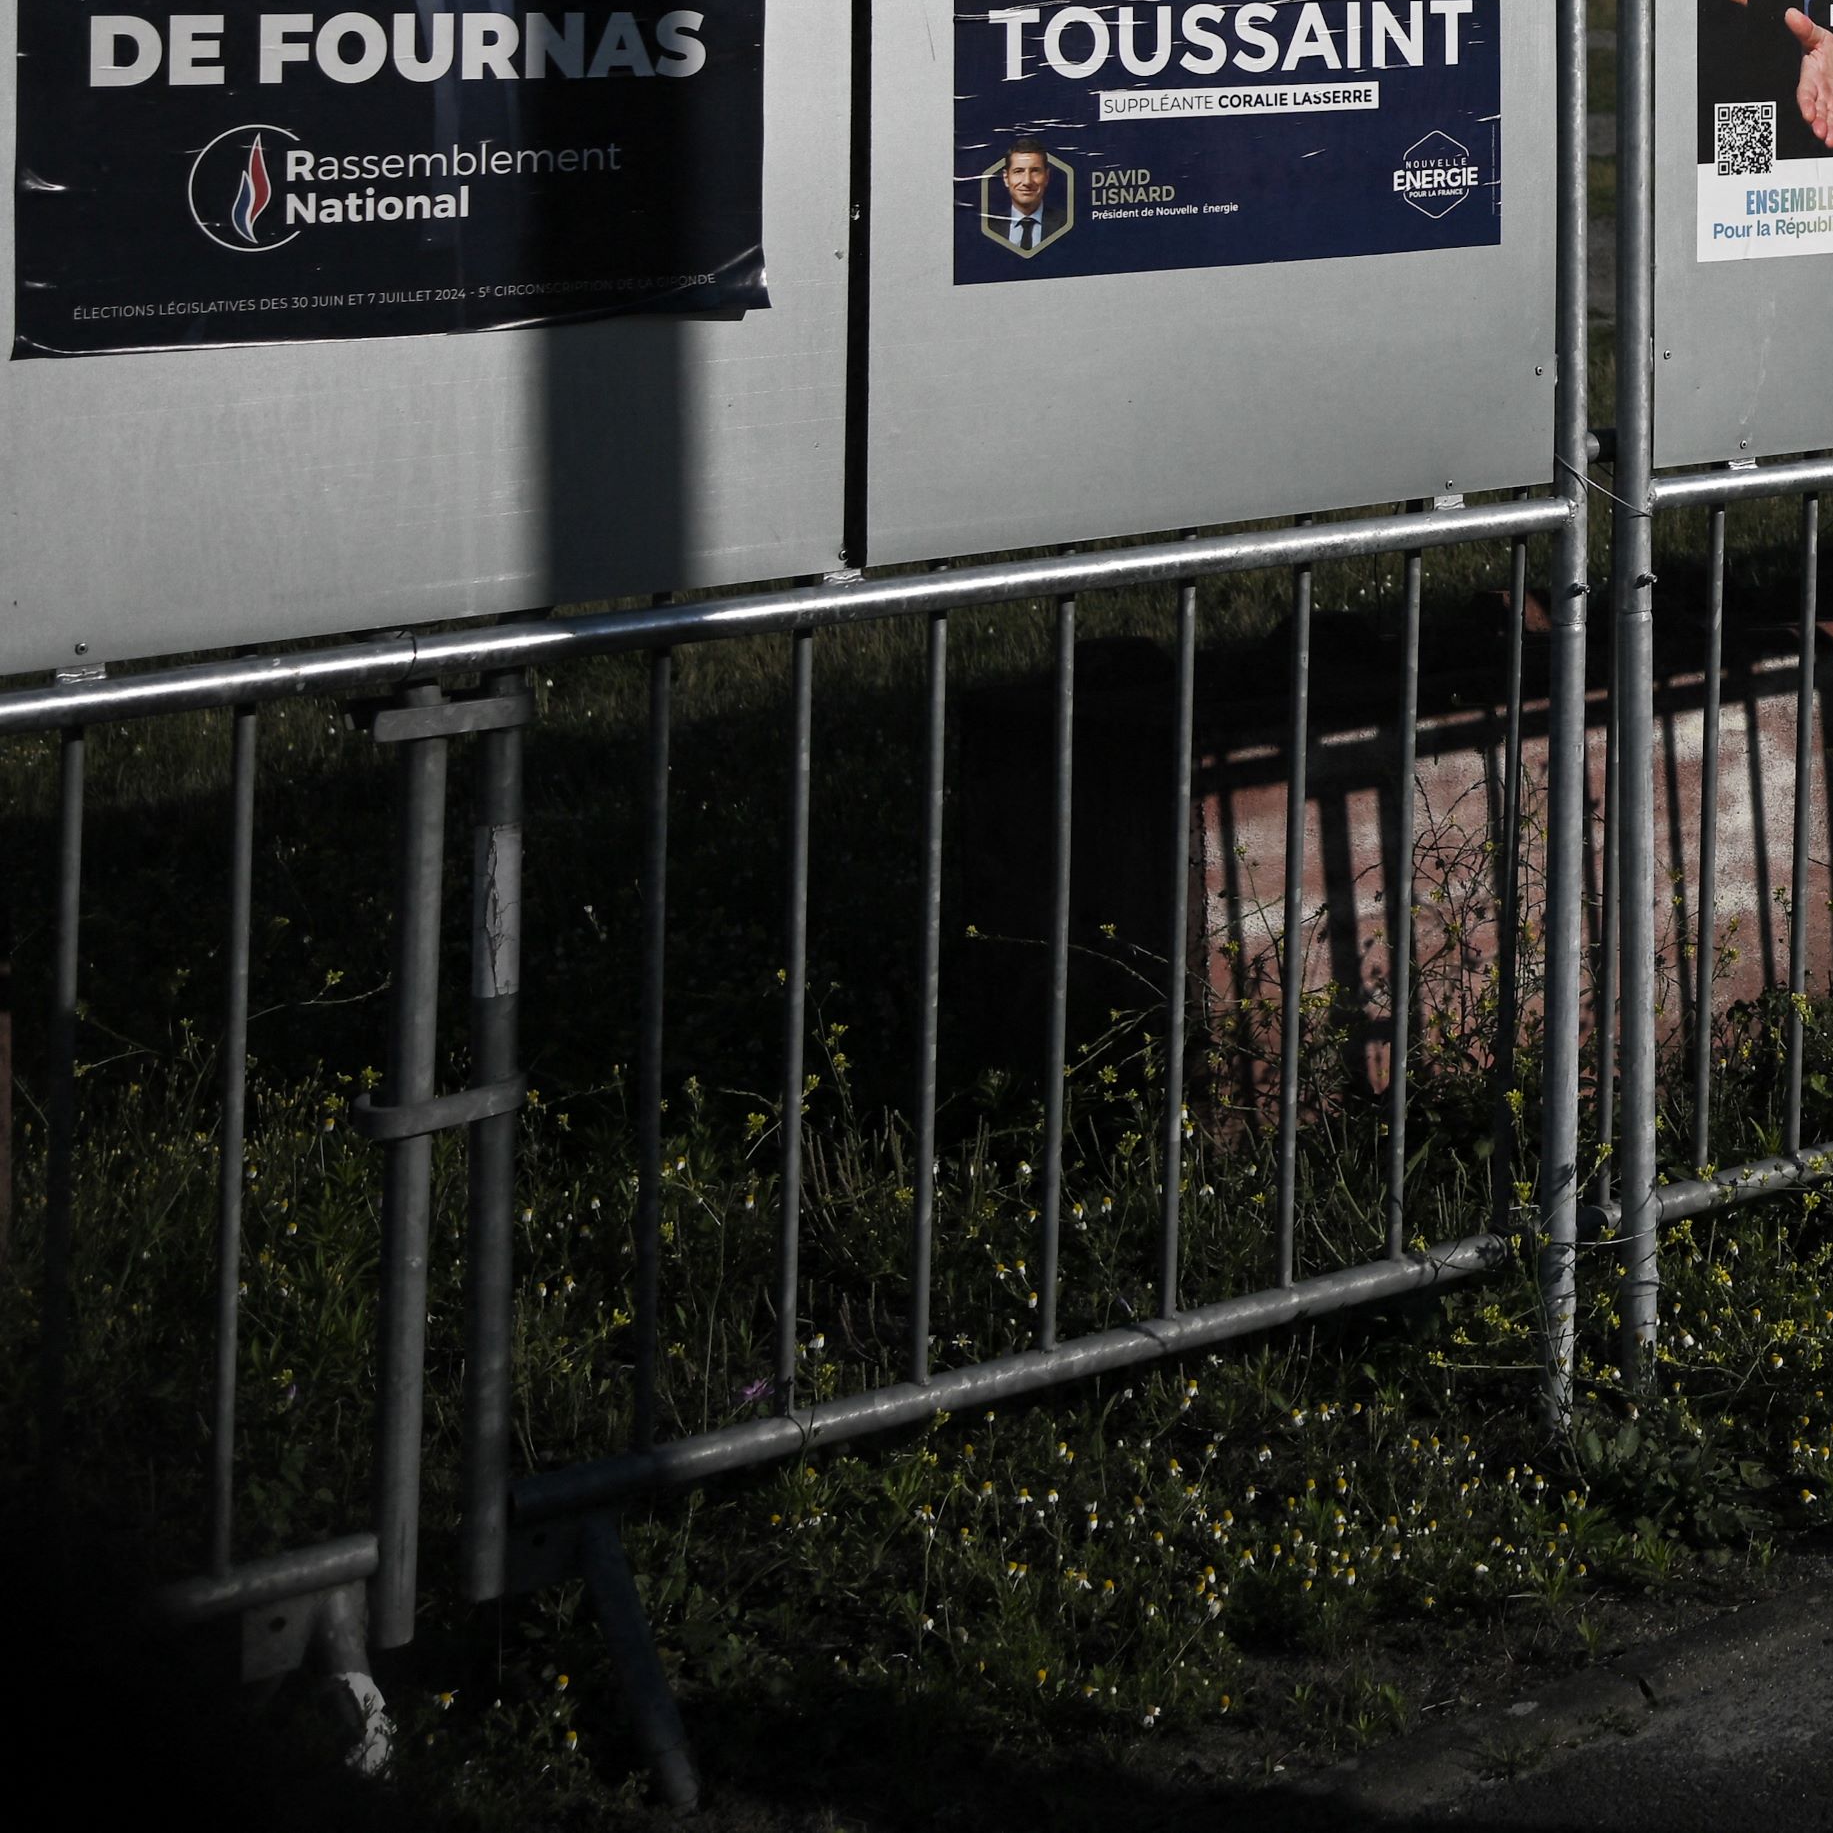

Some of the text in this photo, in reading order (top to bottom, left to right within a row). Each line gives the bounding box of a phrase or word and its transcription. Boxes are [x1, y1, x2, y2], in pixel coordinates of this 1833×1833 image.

[89, 9, 708, 88] DE FOURNAS
[989, 0, 1473, 82] TOUSSAINT
[1104, 89, 1372, 114] SUPPLÉANTE CORALIE LASSERRE
[285, 140, 623, 182] Rassemblement
[1406, 157, 1467, 169] NOUVELLE
[1092, 169, 1150, 188] DAVID
[1092, 185, 1175, 206] LISNARD
[1409, 189, 1427, 198] POUR
[285, 185, 470, 226] National
[1092, 202, 1239, 220] Président de Nouvelle Énergie
[1713, 219, 1752, 240] Pour
[1756, 219, 1771, 237] la
[73, 305, 155, 320] ÉLECTIONS
[158, 299, 256, 316] LÉGISLATIVES
[260, 298, 288, 311] DES
[291, 296, 308, 309] 30
[310, 295, 344, 308] JUIN
[348, 293, 363, 306] ET
[368, 293, 376, 305] 7
[378, 290, 431, 305] JUILLET
[435, 287, 466, 301] 2024
